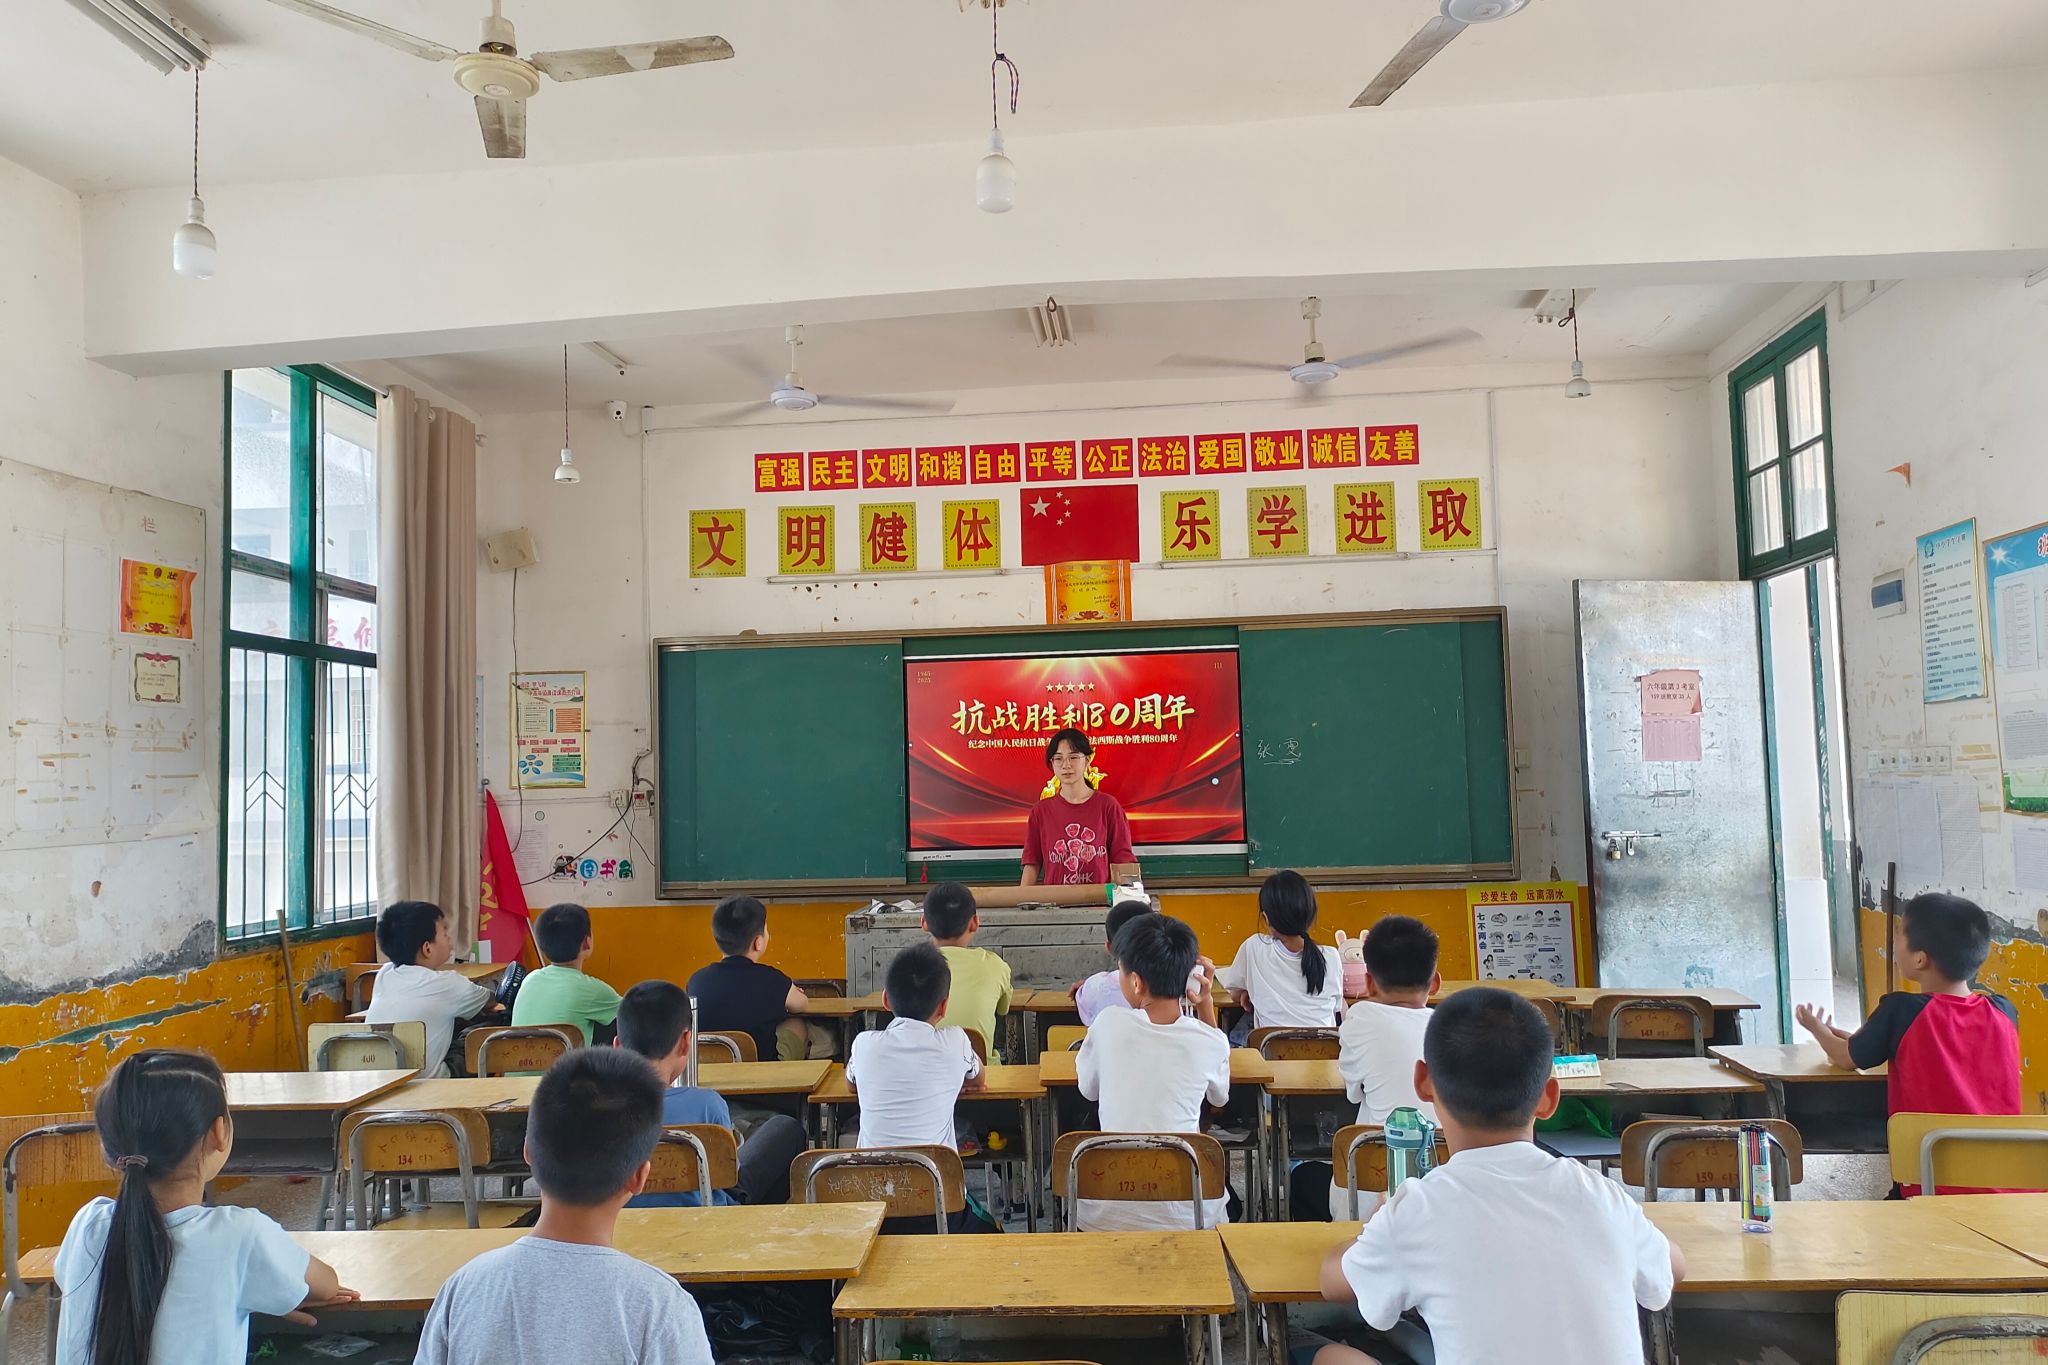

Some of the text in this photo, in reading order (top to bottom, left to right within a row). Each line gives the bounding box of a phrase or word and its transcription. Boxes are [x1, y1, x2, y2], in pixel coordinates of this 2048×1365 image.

[758, 430, 1415, 488] 富强 民主 文明 和谐 自由 平等 公正 法治 爱国 敬业 诚信 友善
[951, 692, 1195, 735] 抗战胜利80周年
[1481, 888, 1565, 902] 珍爱生命 远离溺水
[1477, 912, 1488, 950] 七不两会
[1119, 1180, 1136, 1192] 173
